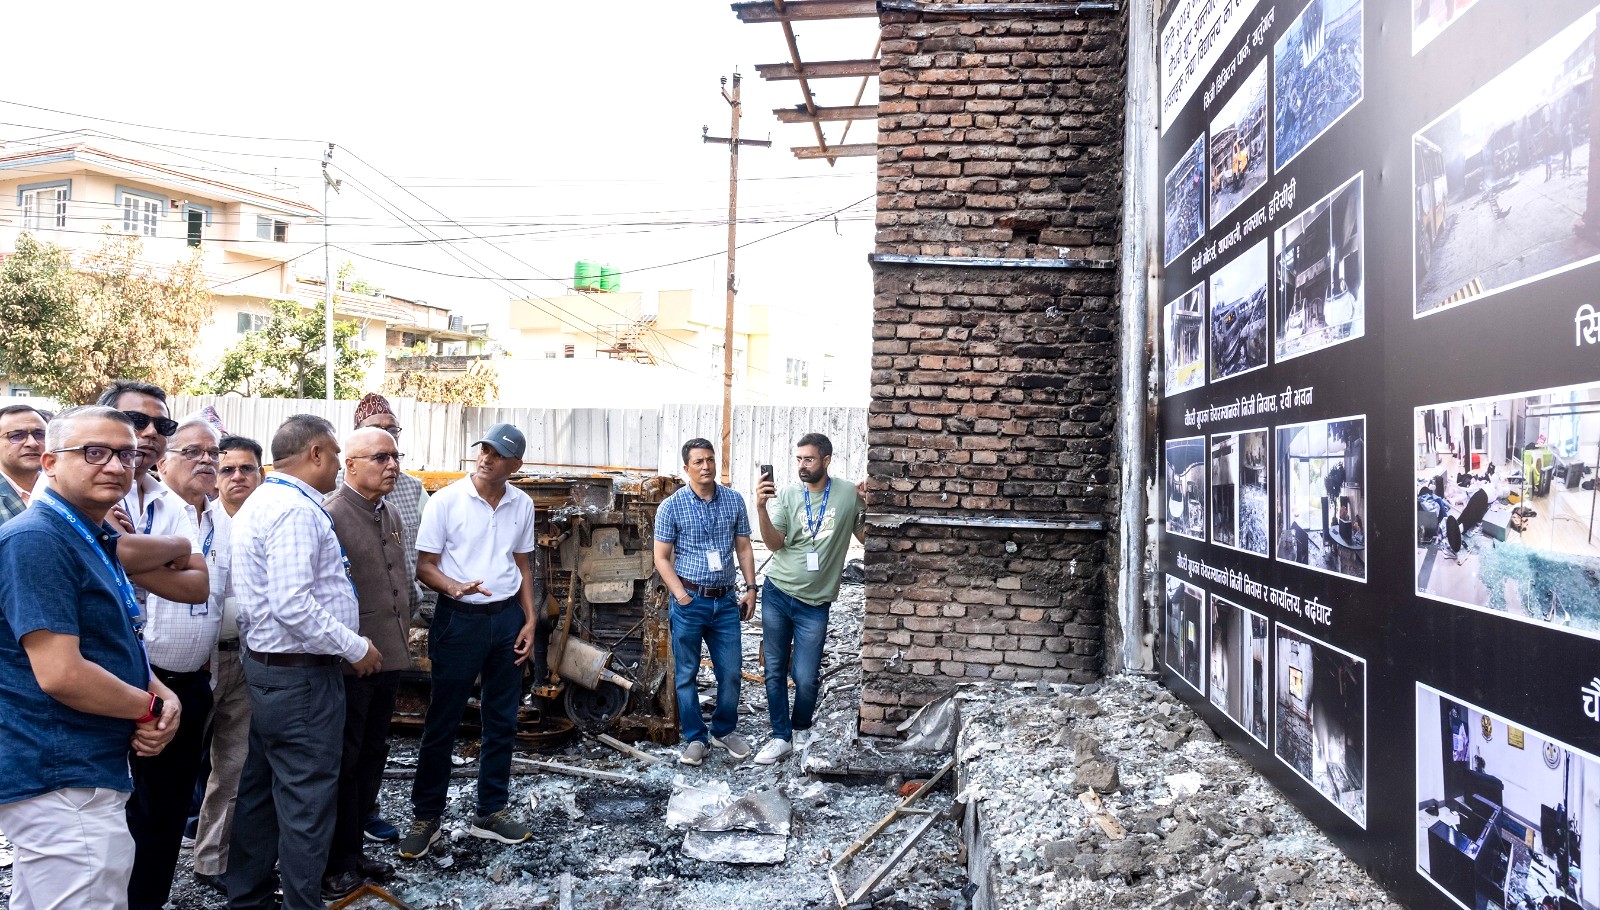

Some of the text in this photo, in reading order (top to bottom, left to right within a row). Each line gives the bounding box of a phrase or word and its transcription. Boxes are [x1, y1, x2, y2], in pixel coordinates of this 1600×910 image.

[1293, 386, 1314, 408] भवन
[1243, 573, 1262, 600] निवास
[1263, 584, 1269, 603] र
[1270, 586, 1302, 618] कार्यालय,
